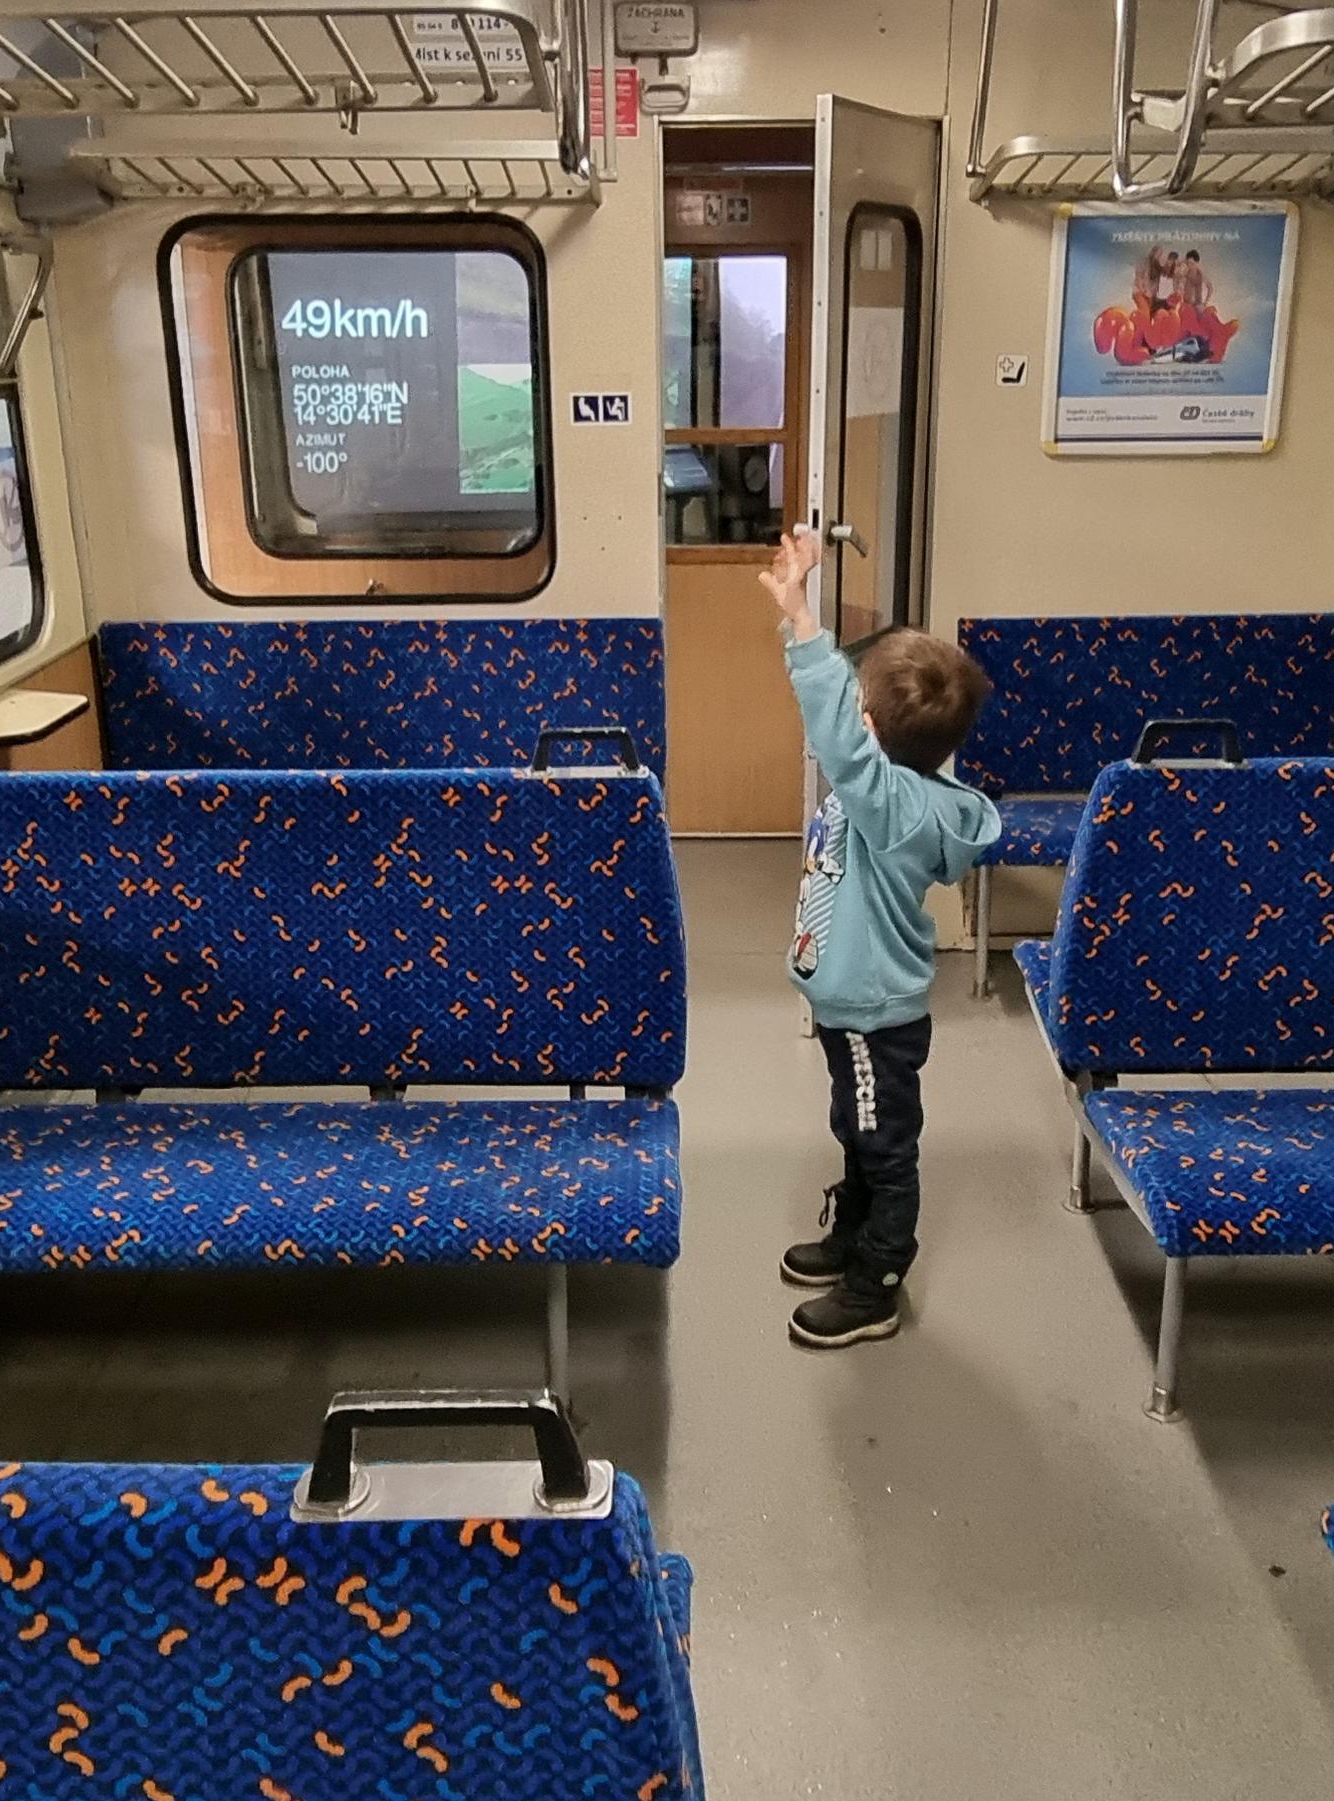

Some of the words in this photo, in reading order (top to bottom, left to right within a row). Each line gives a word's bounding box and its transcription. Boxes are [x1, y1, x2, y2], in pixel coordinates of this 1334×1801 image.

[443, 47, 452, 61] k
[505, 48, 523, 61] 55
[291, 364, 351, 379] POLOHA
[295, 432, 347, 447] AZIMUT
